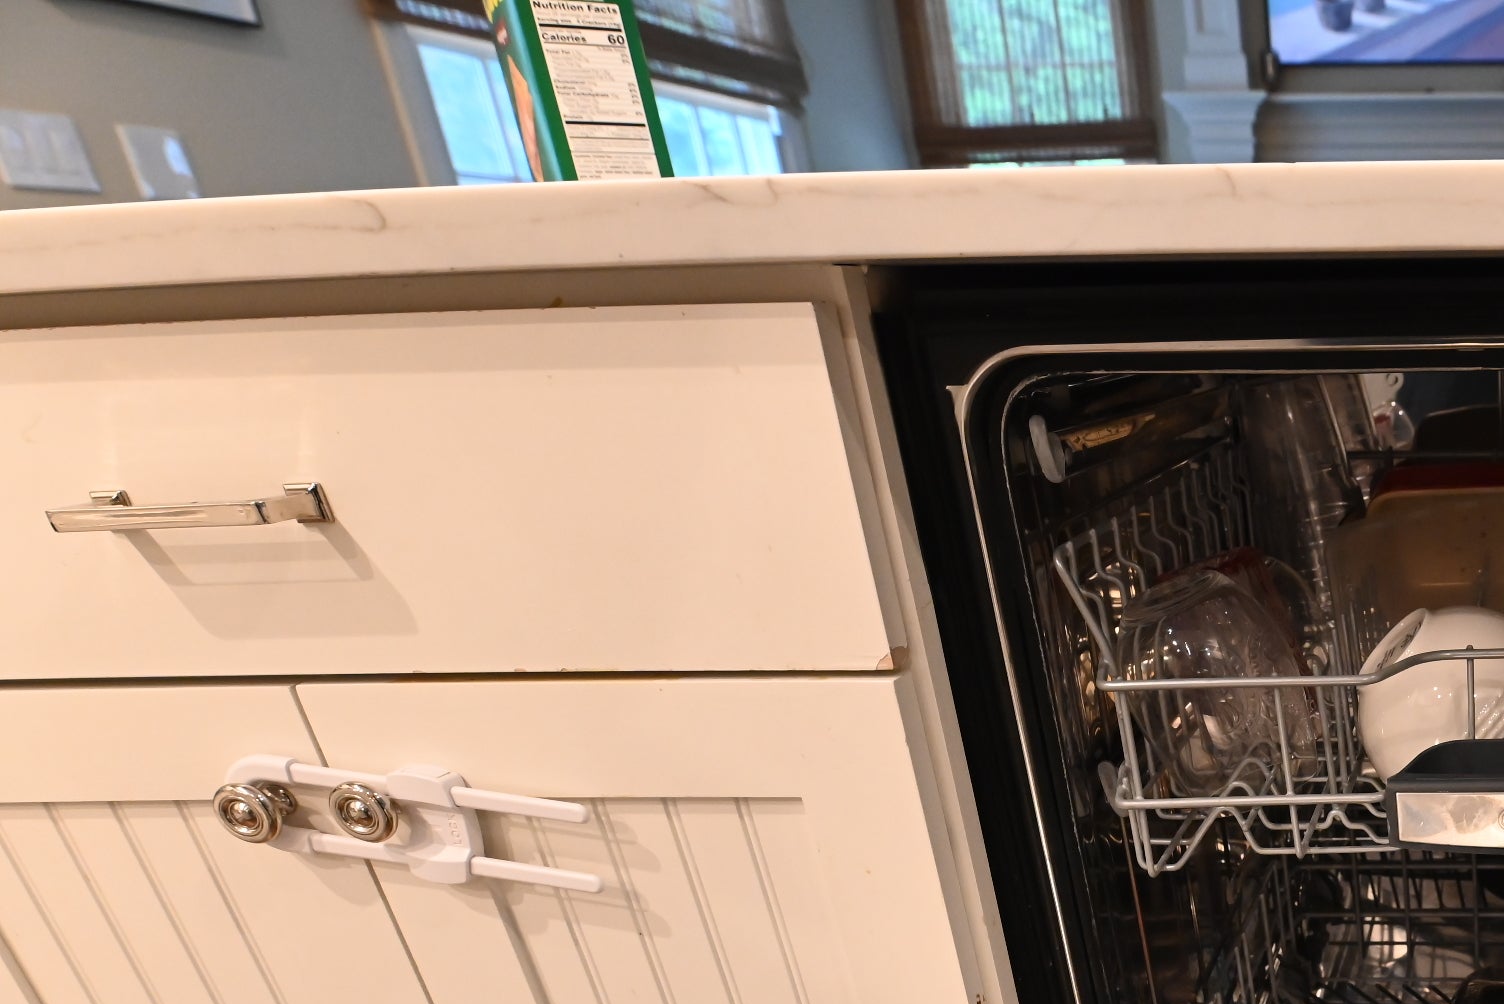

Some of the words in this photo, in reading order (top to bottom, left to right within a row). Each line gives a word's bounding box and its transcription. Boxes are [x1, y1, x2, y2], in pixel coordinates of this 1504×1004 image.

[532, 1, 584, 12] Nutrition
[587, 4, 617, 14] Facts
[541, 32, 587, 43] Calories
[607, 34, 625, 45] 60
